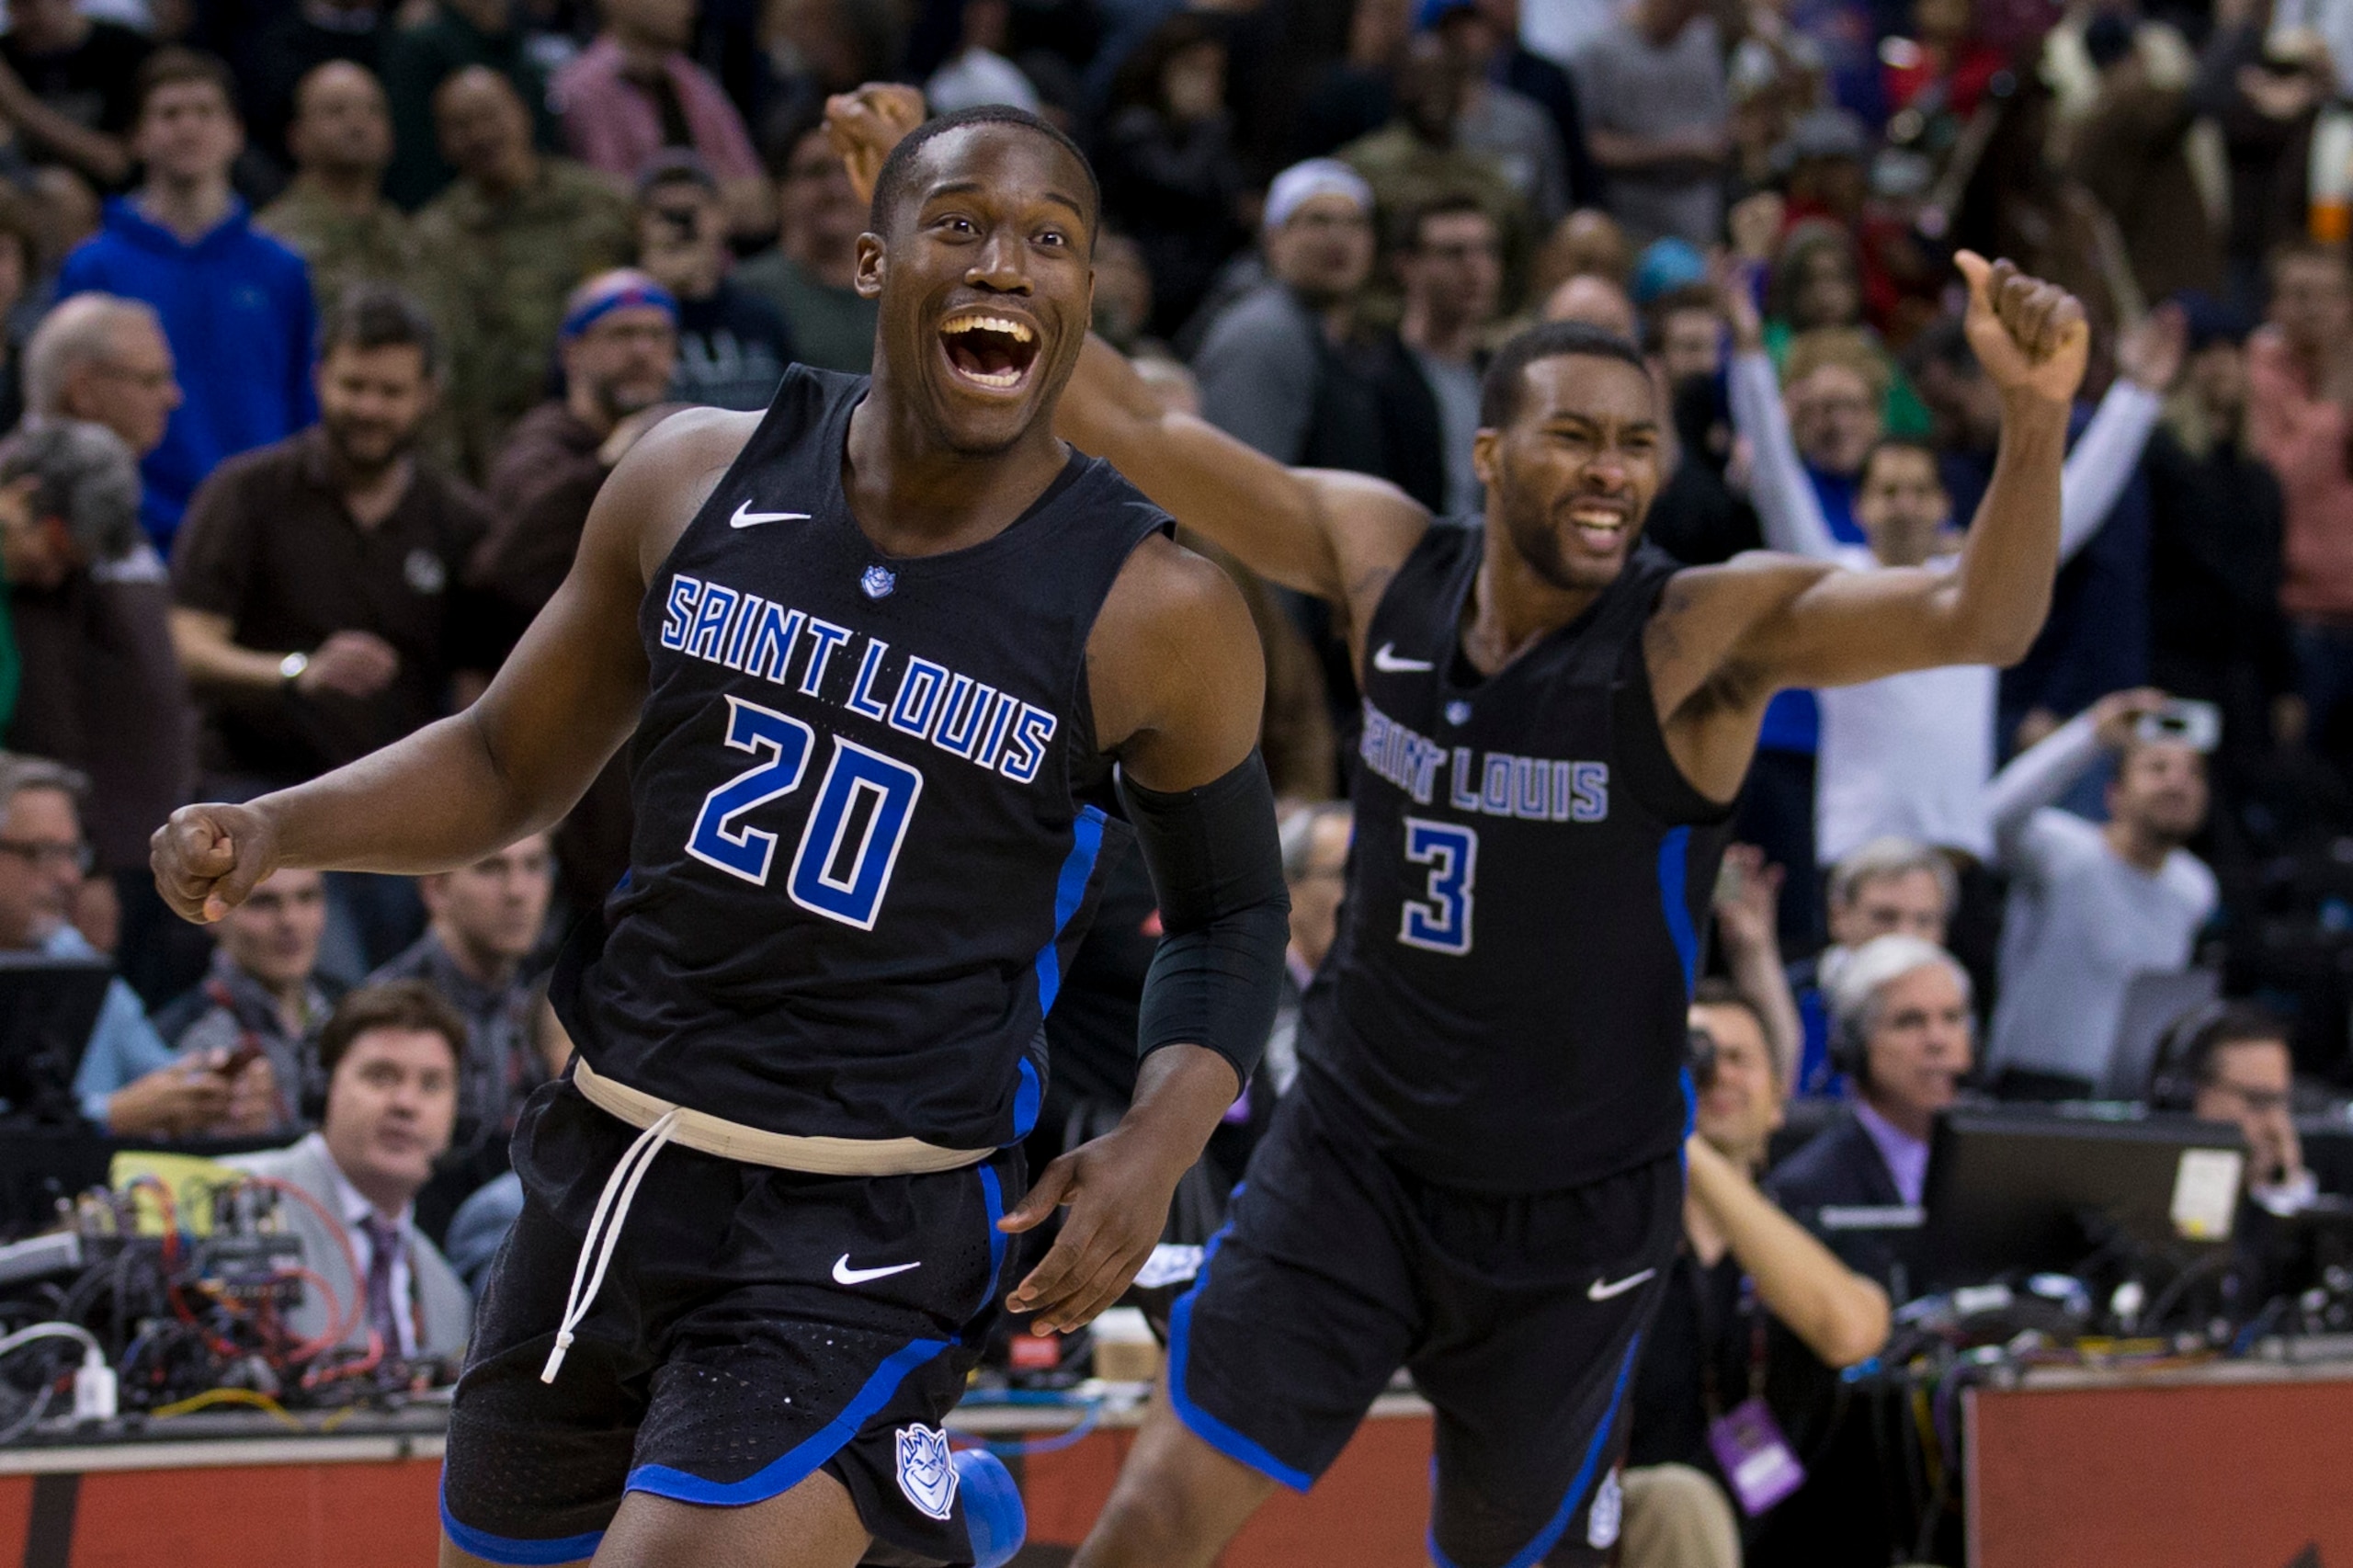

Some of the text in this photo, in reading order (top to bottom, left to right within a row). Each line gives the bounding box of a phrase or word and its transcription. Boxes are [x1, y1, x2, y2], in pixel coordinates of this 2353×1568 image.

[660, 574, 1058, 784] SAINT LOUIS
[684, 693, 924, 932] 20
[1449, 746, 1609, 823] LOUIS
[1397, 816, 1479, 957] 3
